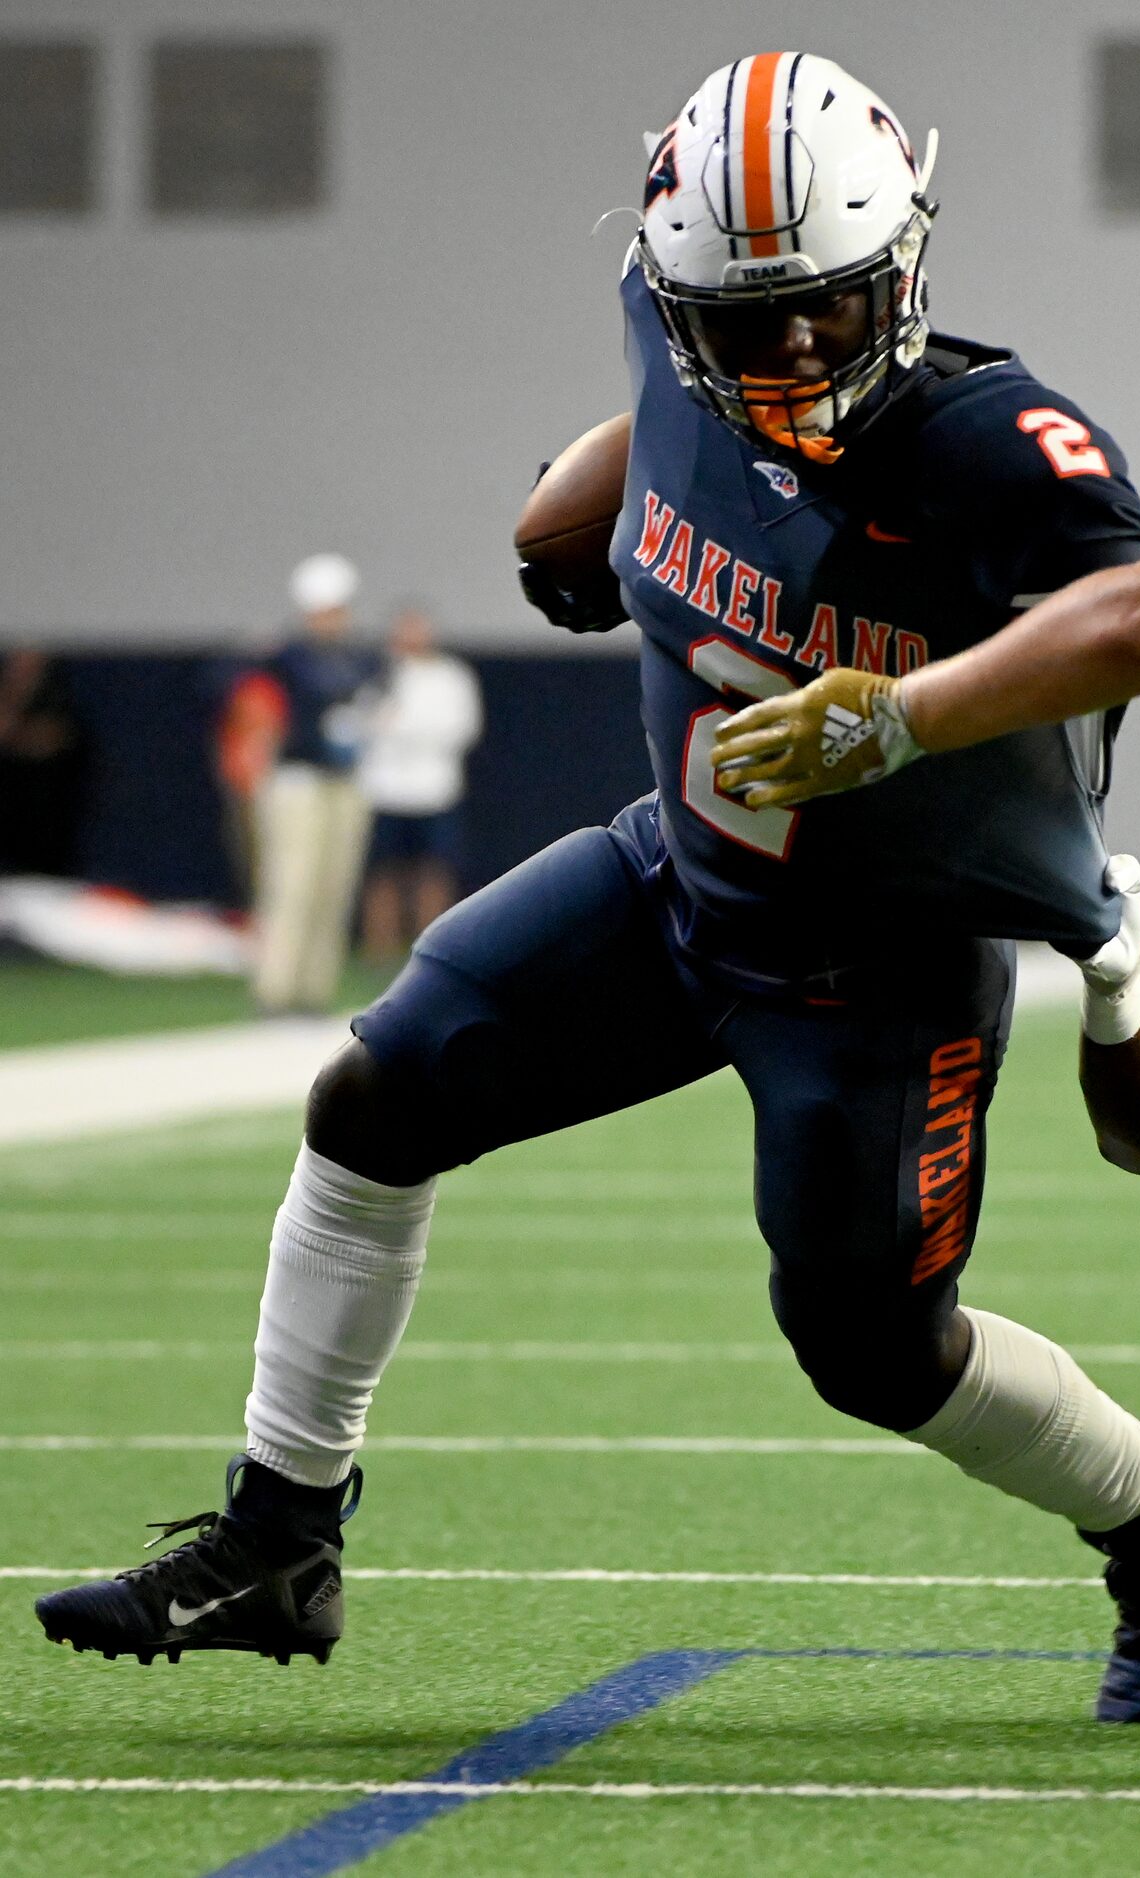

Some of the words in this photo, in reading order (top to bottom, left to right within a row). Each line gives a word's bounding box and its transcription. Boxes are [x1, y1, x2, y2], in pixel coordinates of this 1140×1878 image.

[741, 263, 787, 281] TEAM
[1016, 407, 1111, 480] 2
[632, 489, 929, 675] WAKELAND
[682, 632, 800, 863] 2
[910, 1036, 984, 1287] WAKELAND
